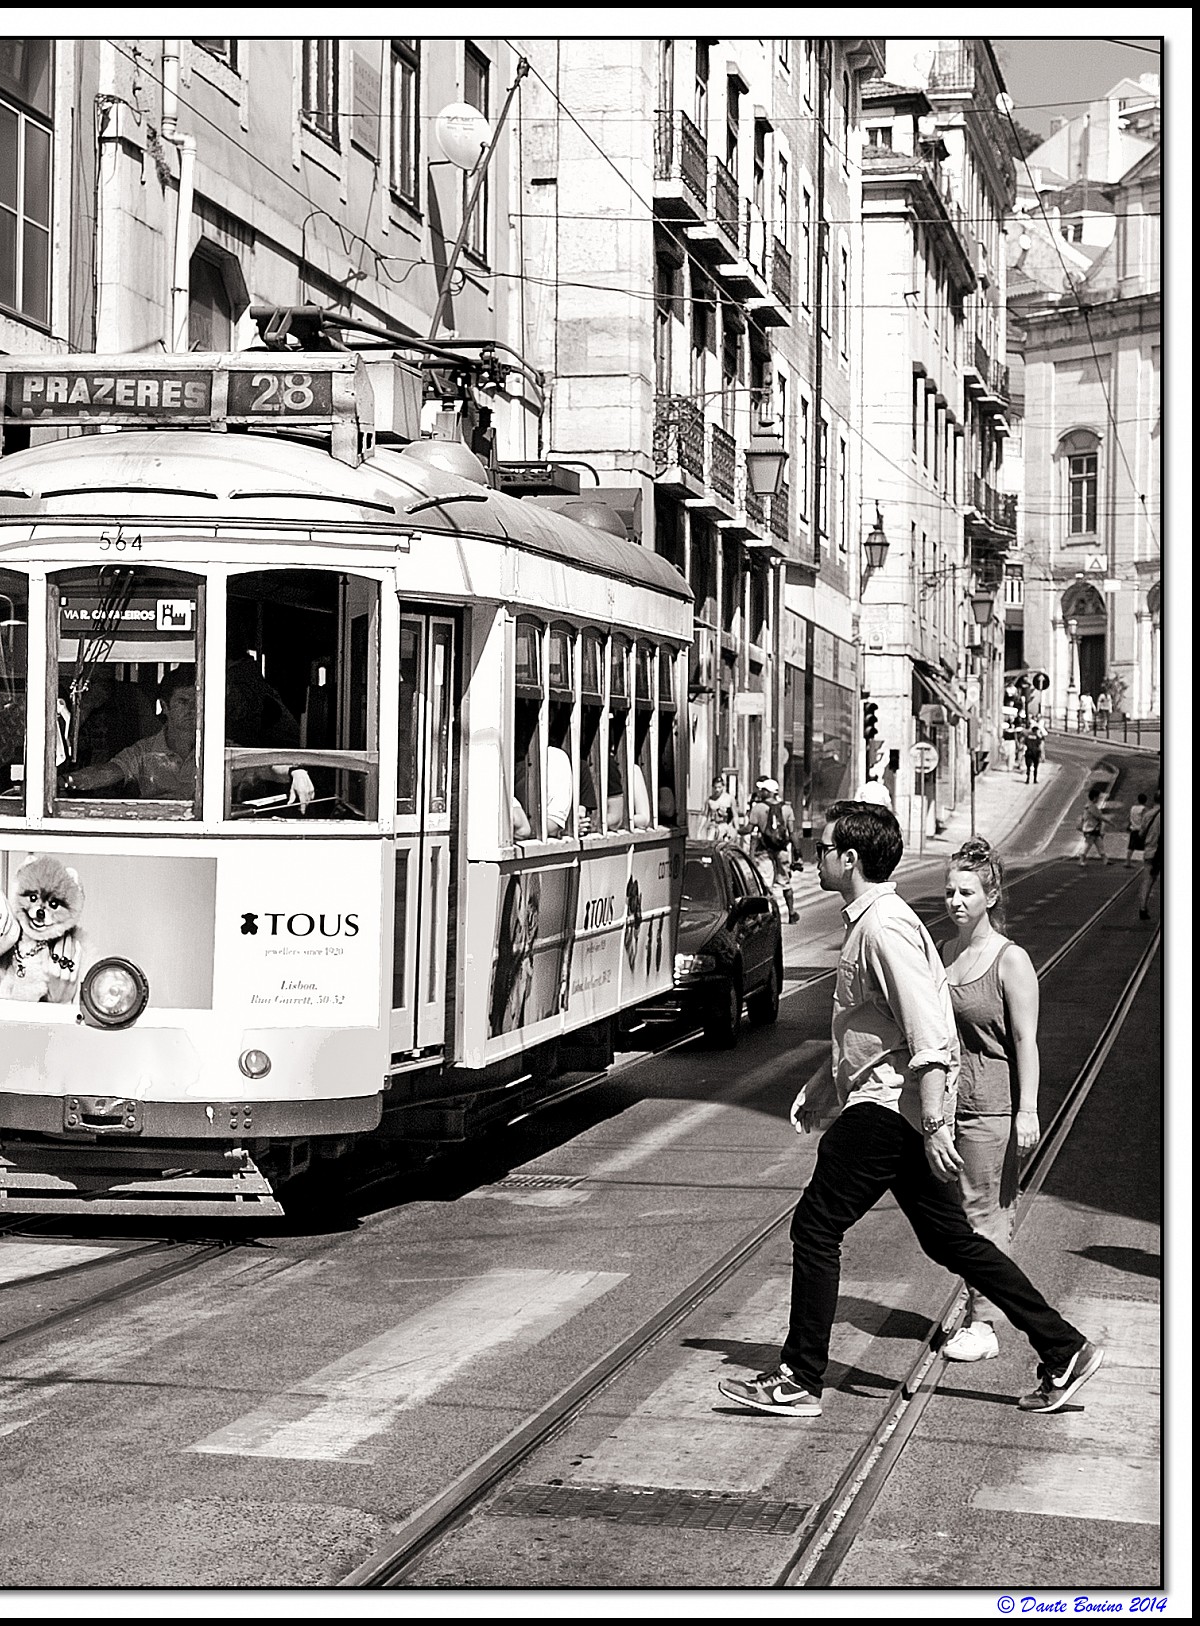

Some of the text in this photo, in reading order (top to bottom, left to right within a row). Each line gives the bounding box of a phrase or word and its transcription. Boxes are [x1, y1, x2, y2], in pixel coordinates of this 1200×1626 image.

[22, 376, 207, 409] PRAZERES
[250, 373, 314, 412] 28
[99, 531, 143, 551] 564
[63, 609, 80, 620] VIA
[264, 913, 359, 937] TOUS
